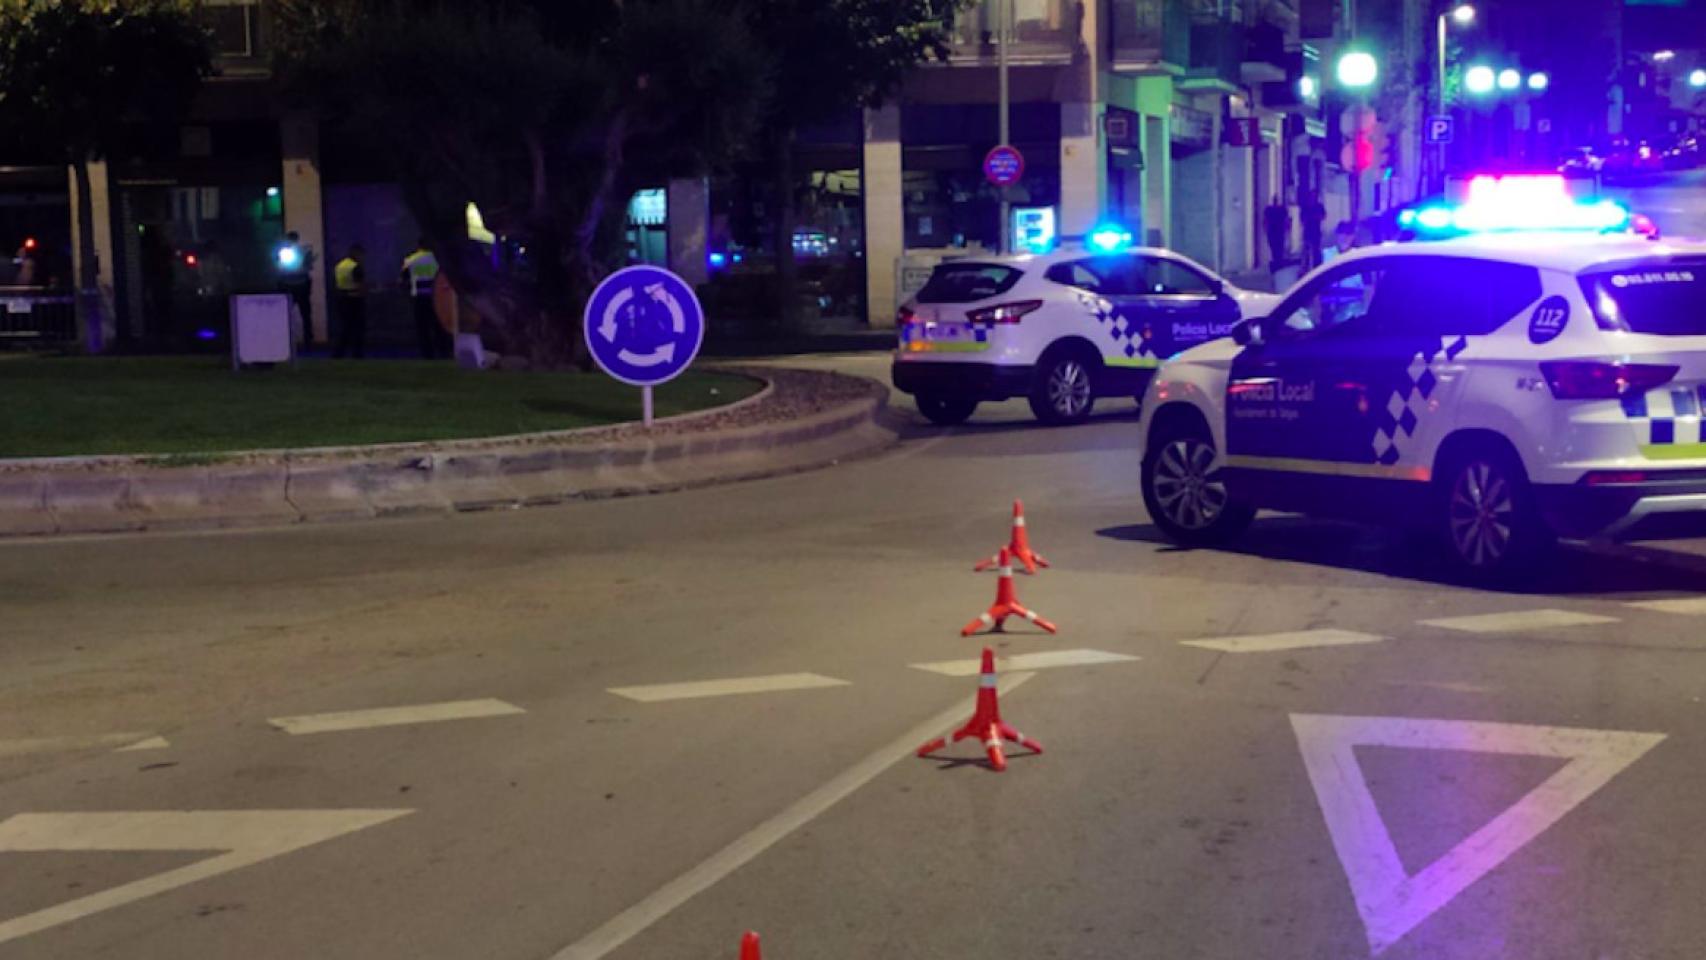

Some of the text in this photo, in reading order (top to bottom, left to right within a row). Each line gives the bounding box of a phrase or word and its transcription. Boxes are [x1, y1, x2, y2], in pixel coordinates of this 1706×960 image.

[1431, 120, 1447, 140] P
[1535, 308, 1564, 327] 112
[1278, 379, 1315, 401] Local
